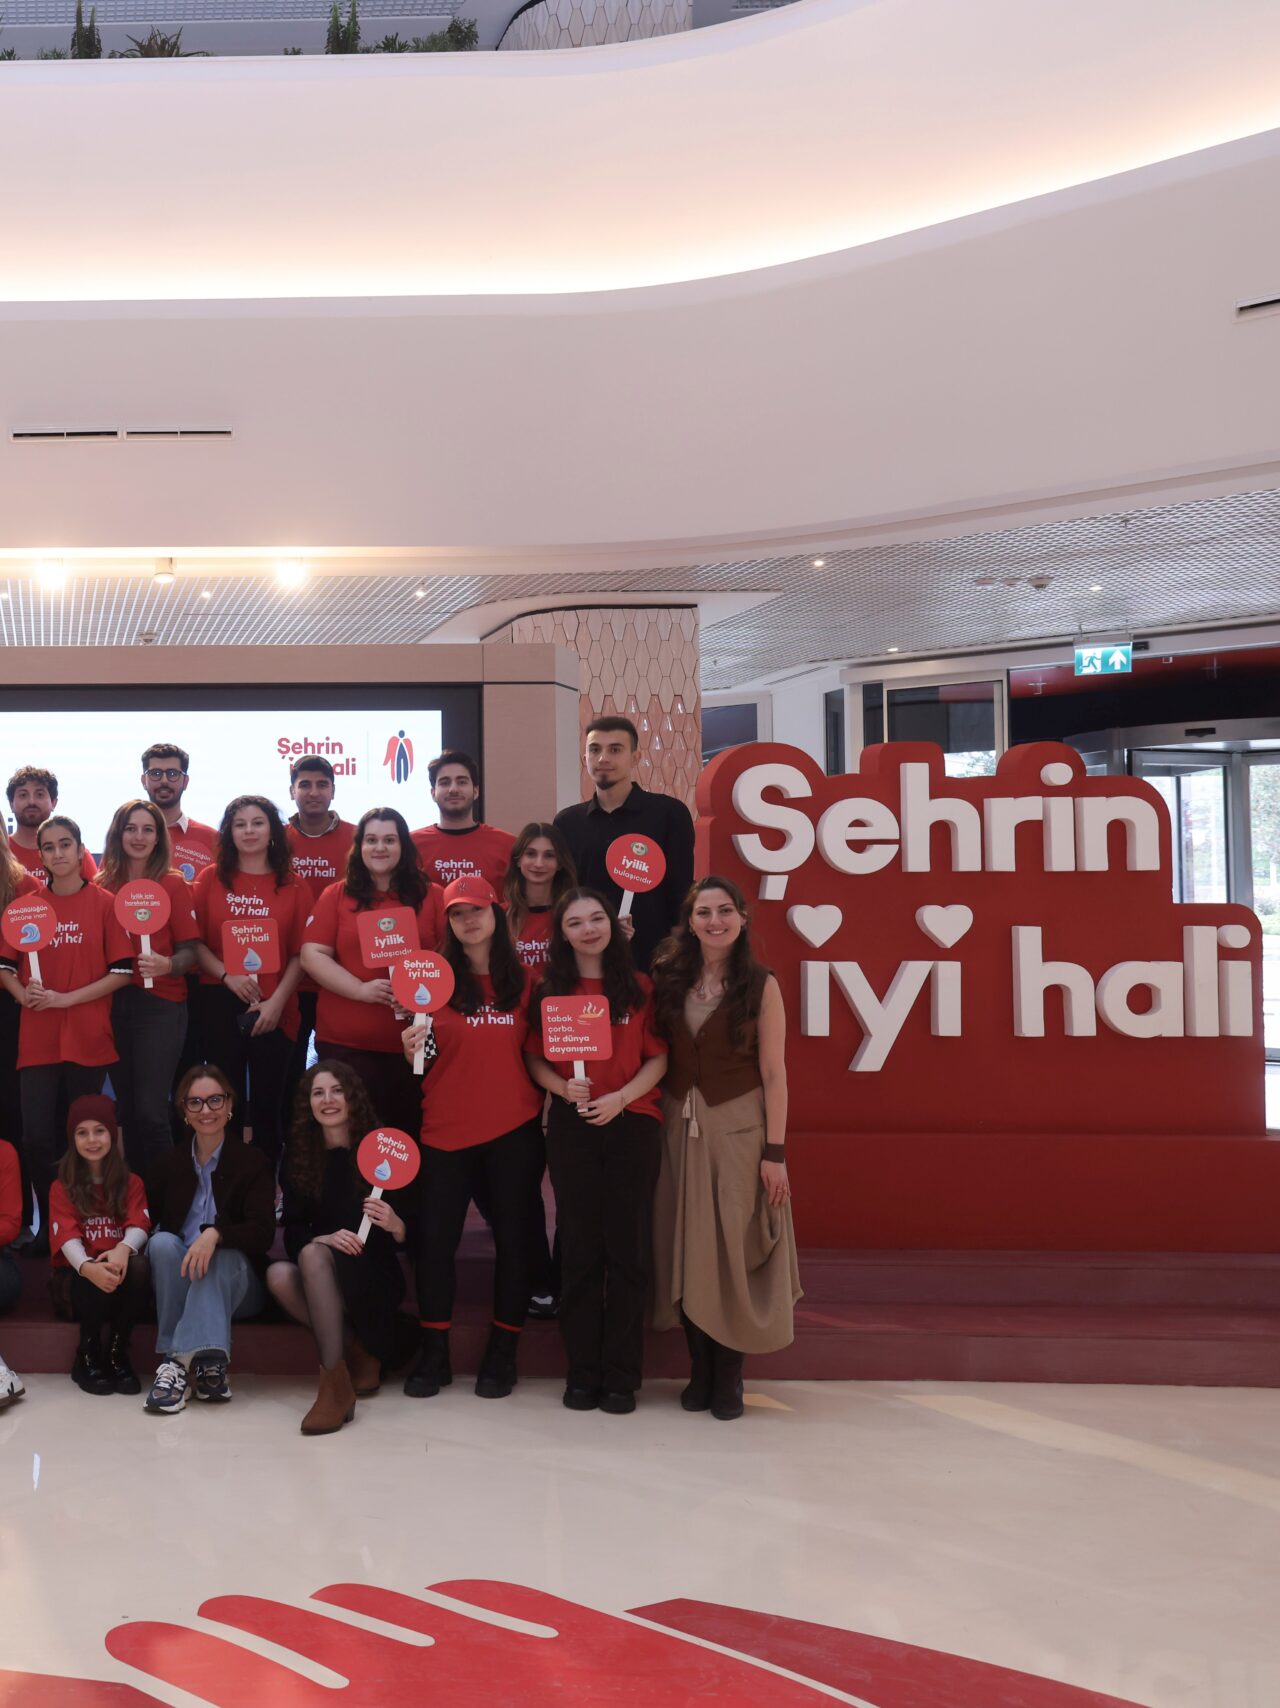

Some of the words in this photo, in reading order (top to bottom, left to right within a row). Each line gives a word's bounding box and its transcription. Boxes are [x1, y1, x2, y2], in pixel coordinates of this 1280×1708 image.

[277, 736, 344, 759] Şehrin
[333, 757, 357, 775] ali
[731, 762, 1160, 900] Şehrin
[292, 857, 329, 868] Şehrin
[434, 859, 474, 871] Şehrin
[621, 855, 650, 873] iyilik
[297, 867, 312, 878] iyi
[314, 868, 336, 878] hali
[441, 868, 457, 883] iyi
[226, 893, 264, 905] Şehrin
[230, 903, 246, 916] iyi
[248, 906, 270, 916] hali
[231, 925, 263, 936] Şehrin
[237, 934, 250, 945] iyi
[251, 933, 269, 942] hali
[374, 933, 405, 949] iyilik
[523, 951, 540, 966] iyi
[403, 960, 435, 971] Şehrin
[408, 969, 421, 980] iyi
[422, 969, 440, 978] hali
[786, 904, 974, 1072] iyi
[1011, 924, 1253, 1039] hali
[487, 1014, 514, 1026] hali
[548, 1035, 560, 1043] bir
[562, 1034, 590, 1043] dünya
[549, 1045, 598, 1055] dayanışma
[376, 1132, 406, 1151] Şehrin
[377, 1141, 391, 1154] iyi
[390, 1148, 409, 1162] hali
[85, 1226, 102, 1241] iyi
